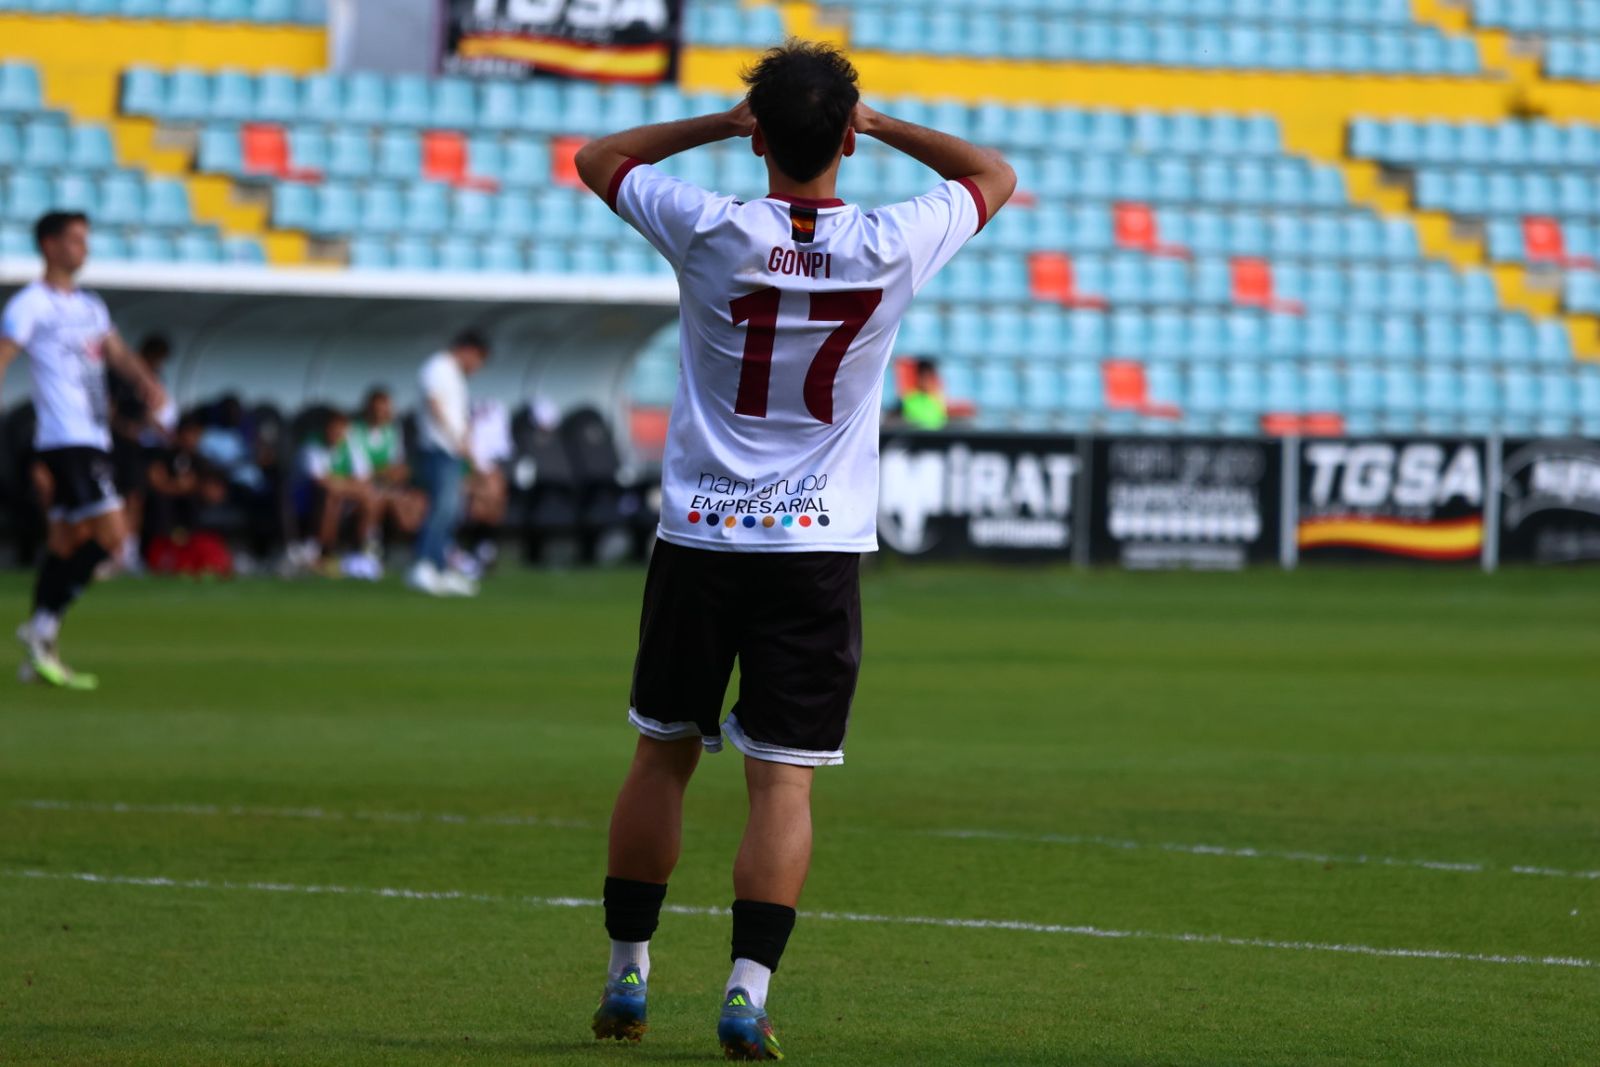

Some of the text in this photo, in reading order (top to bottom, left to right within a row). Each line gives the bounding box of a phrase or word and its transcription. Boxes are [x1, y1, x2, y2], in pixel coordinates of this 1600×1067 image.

[768, 246, 831, 279] GONPI
[729, 286, 883, 424] 17
[698, 471, 828, 500] nani grupo
[1305, 443, 1483, 508] TGSA
[690, 495, 829, 514] EMPRESARIAL
